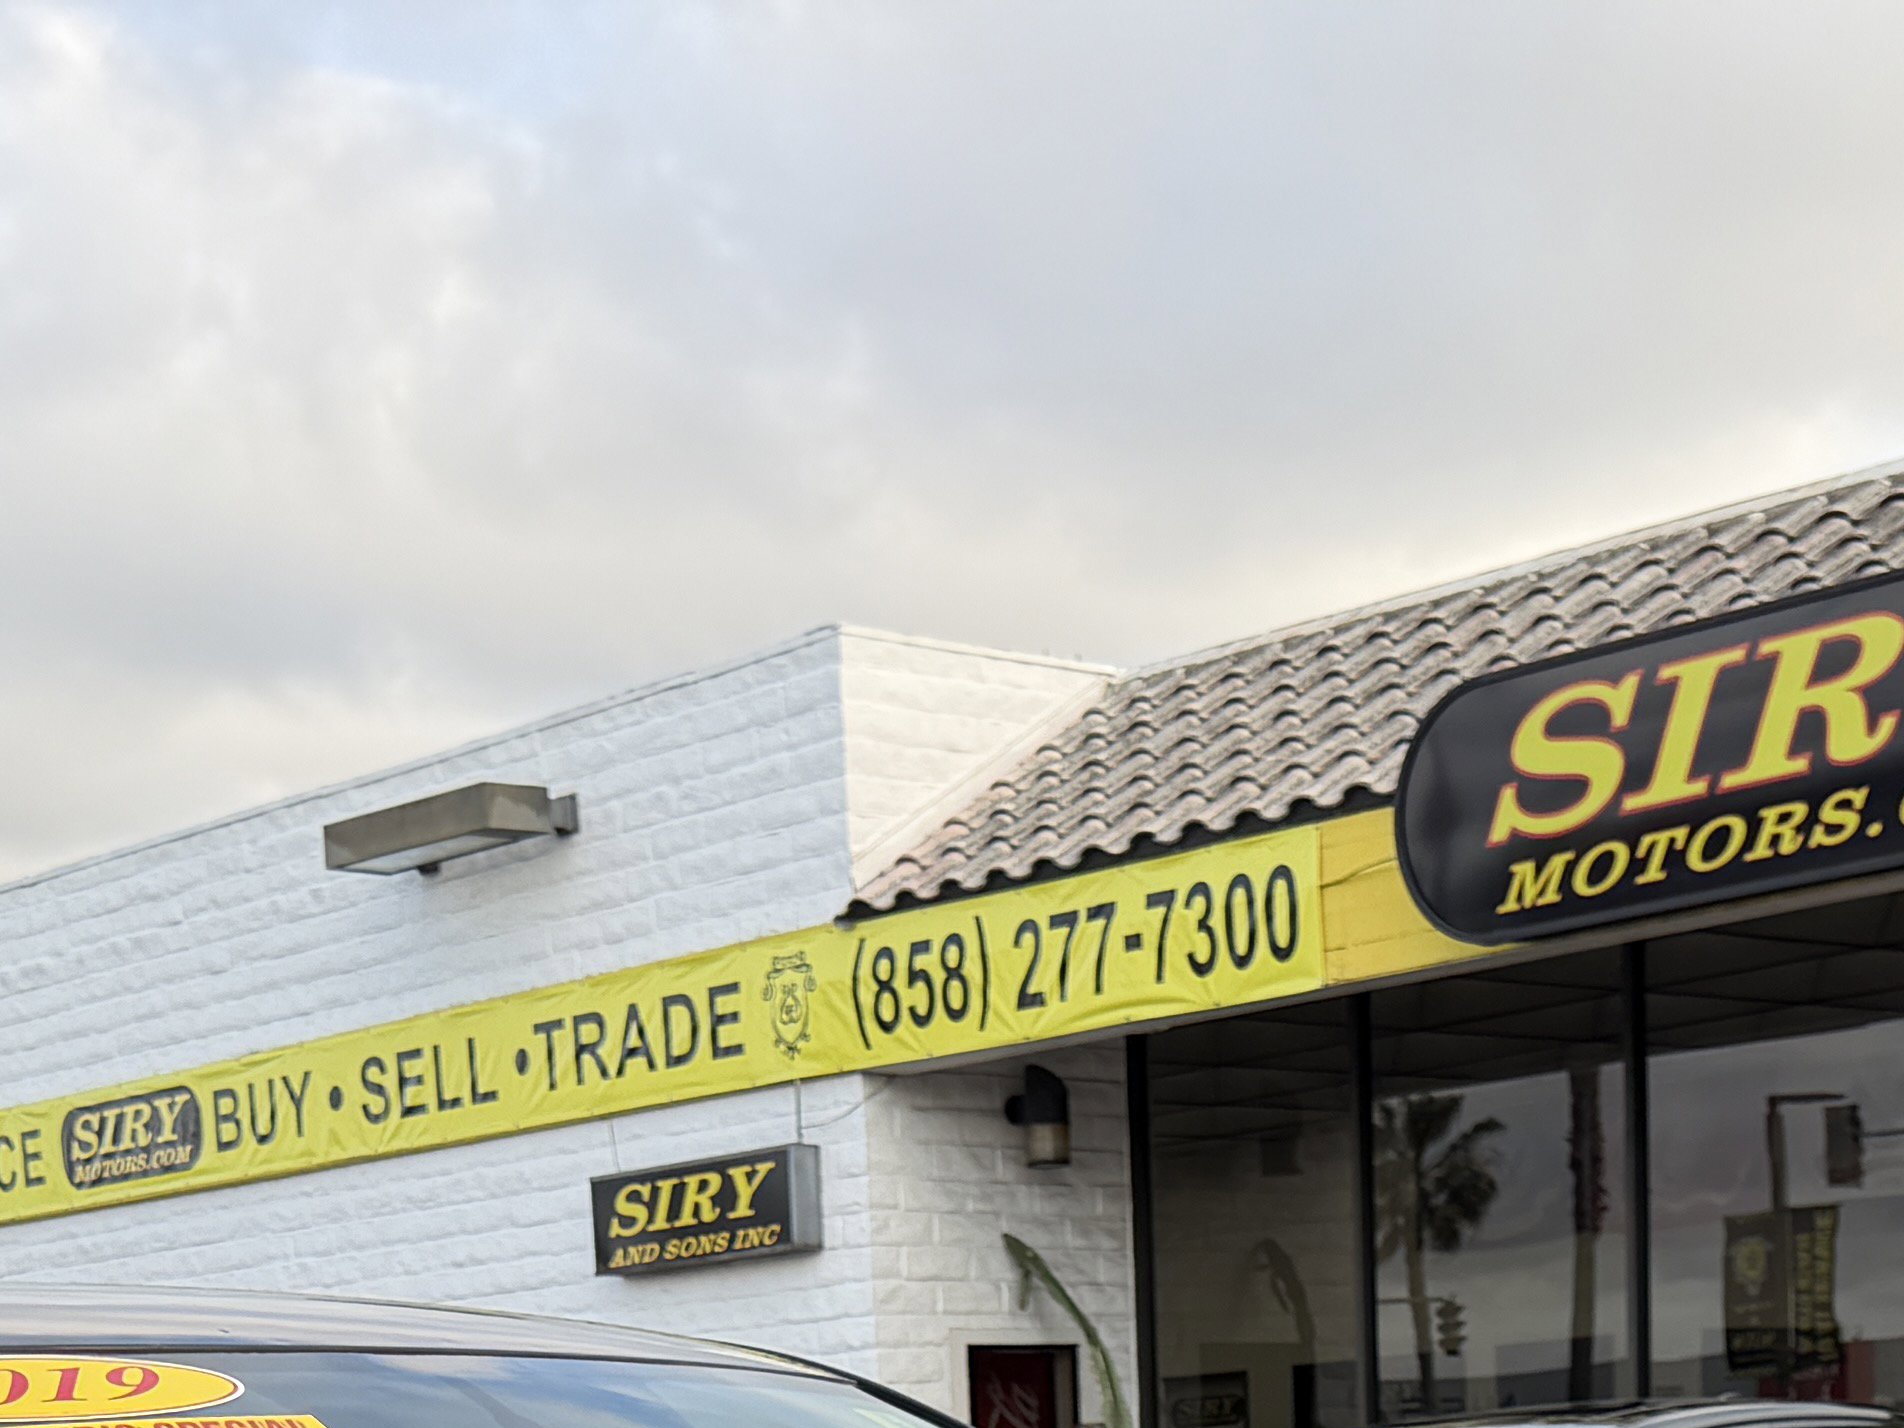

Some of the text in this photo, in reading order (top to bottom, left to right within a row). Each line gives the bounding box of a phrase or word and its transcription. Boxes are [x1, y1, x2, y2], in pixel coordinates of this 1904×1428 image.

[851, 862, 1299, 1050] (858) 277-7300
[214, 981, 746, 1152] BUY SELL TRADE
[71, 1093, 192, 1163] SIRY
[608, 1161, 776, 1239] SIRY
[609, 1223, 782, 1270] AND SONS INC
